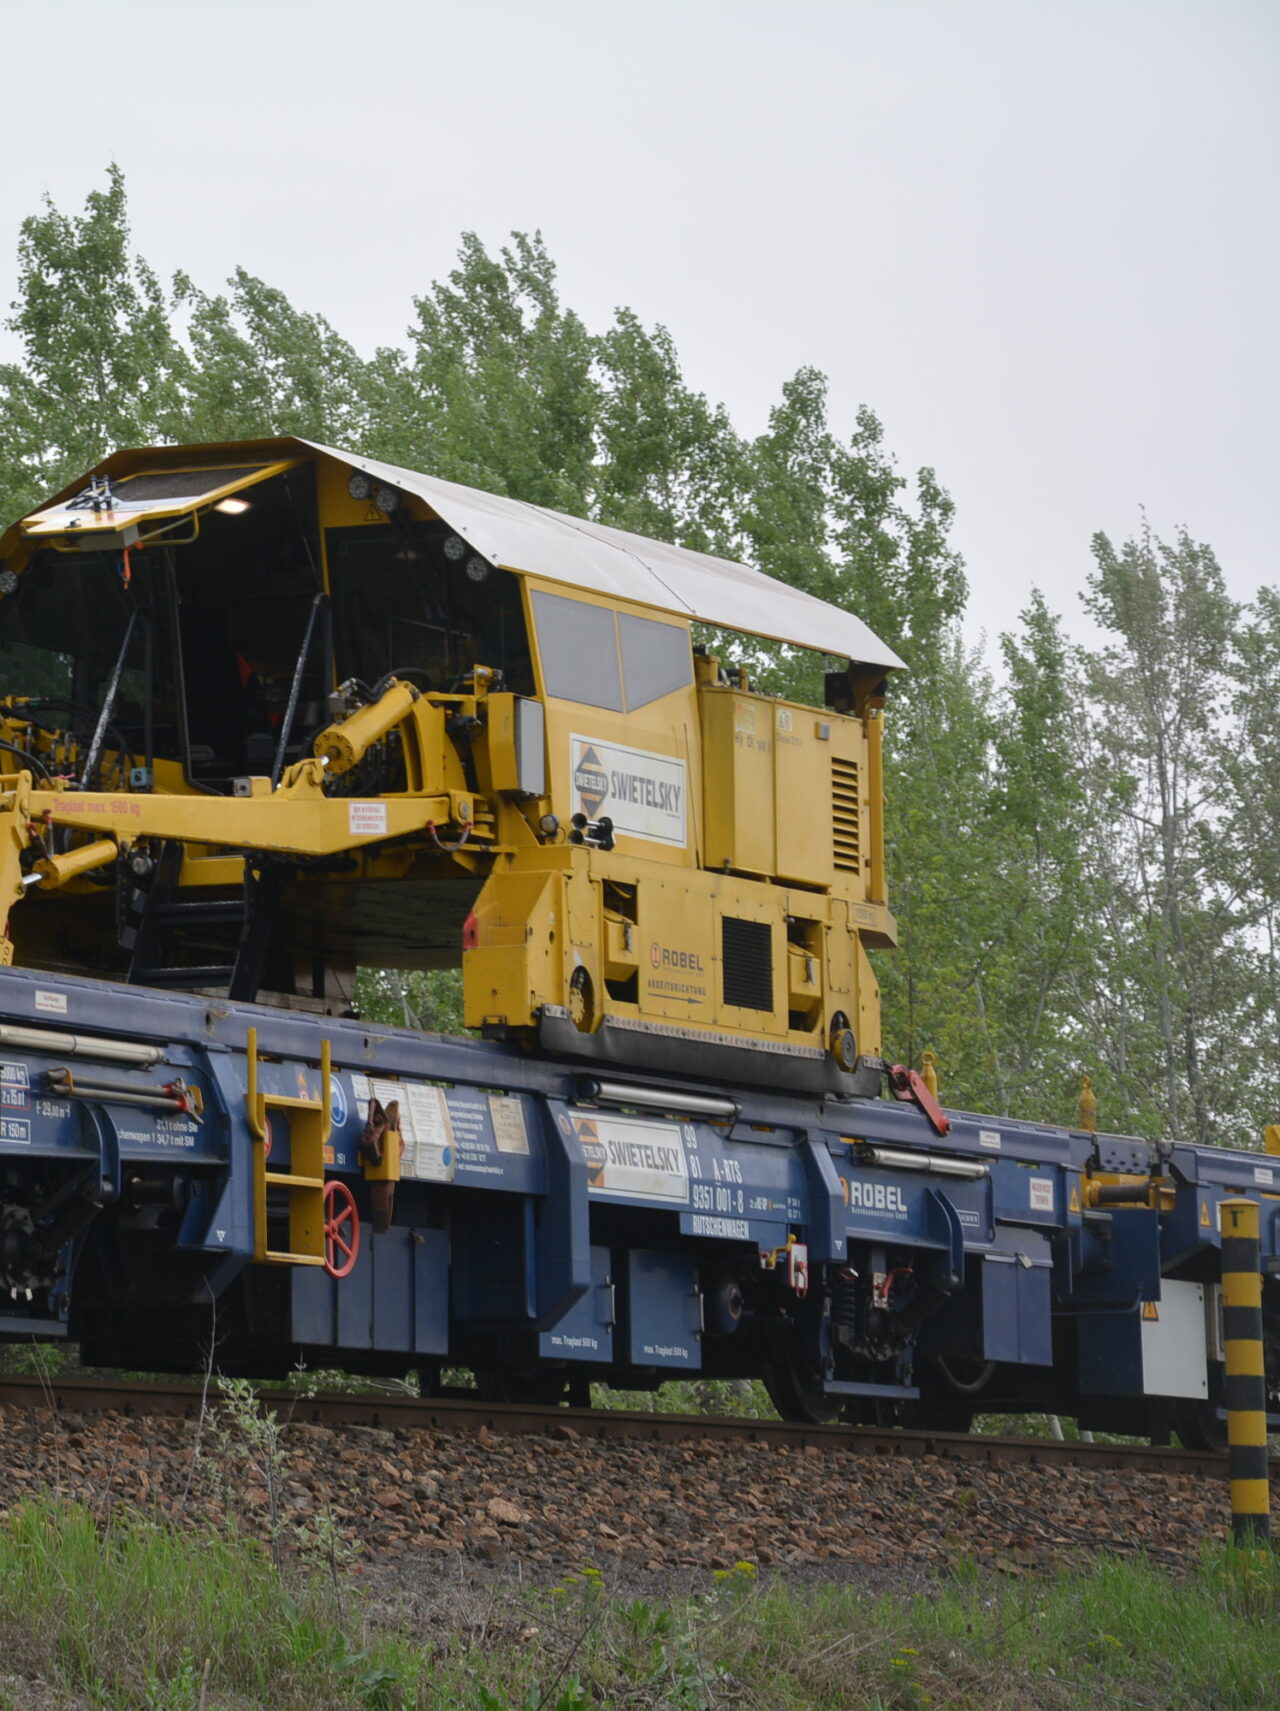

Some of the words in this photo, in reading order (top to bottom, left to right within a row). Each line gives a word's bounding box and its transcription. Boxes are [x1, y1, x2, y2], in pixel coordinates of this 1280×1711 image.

[611, 770, 681, 813] SWIETELSKY
[663, 948, 704, 972] ROBEL
[647, 979, 706, 996] ARBEITSRICHTUNG
[683, 1125, 698, 1149] 99
[583, 1144, 606, 1161] ETELSKY
[608, 1140, 681, 1173] SWIETELSKY
[690, 1155, 702, 1179] 81
[693, 1184, 714, 1210] 9351
[851, 1181, 908, 1212] ROBEL
[693, 1214, 749, 1240] RUTSCHENWAGEN
[591, 1338, 598, 1350] kg
